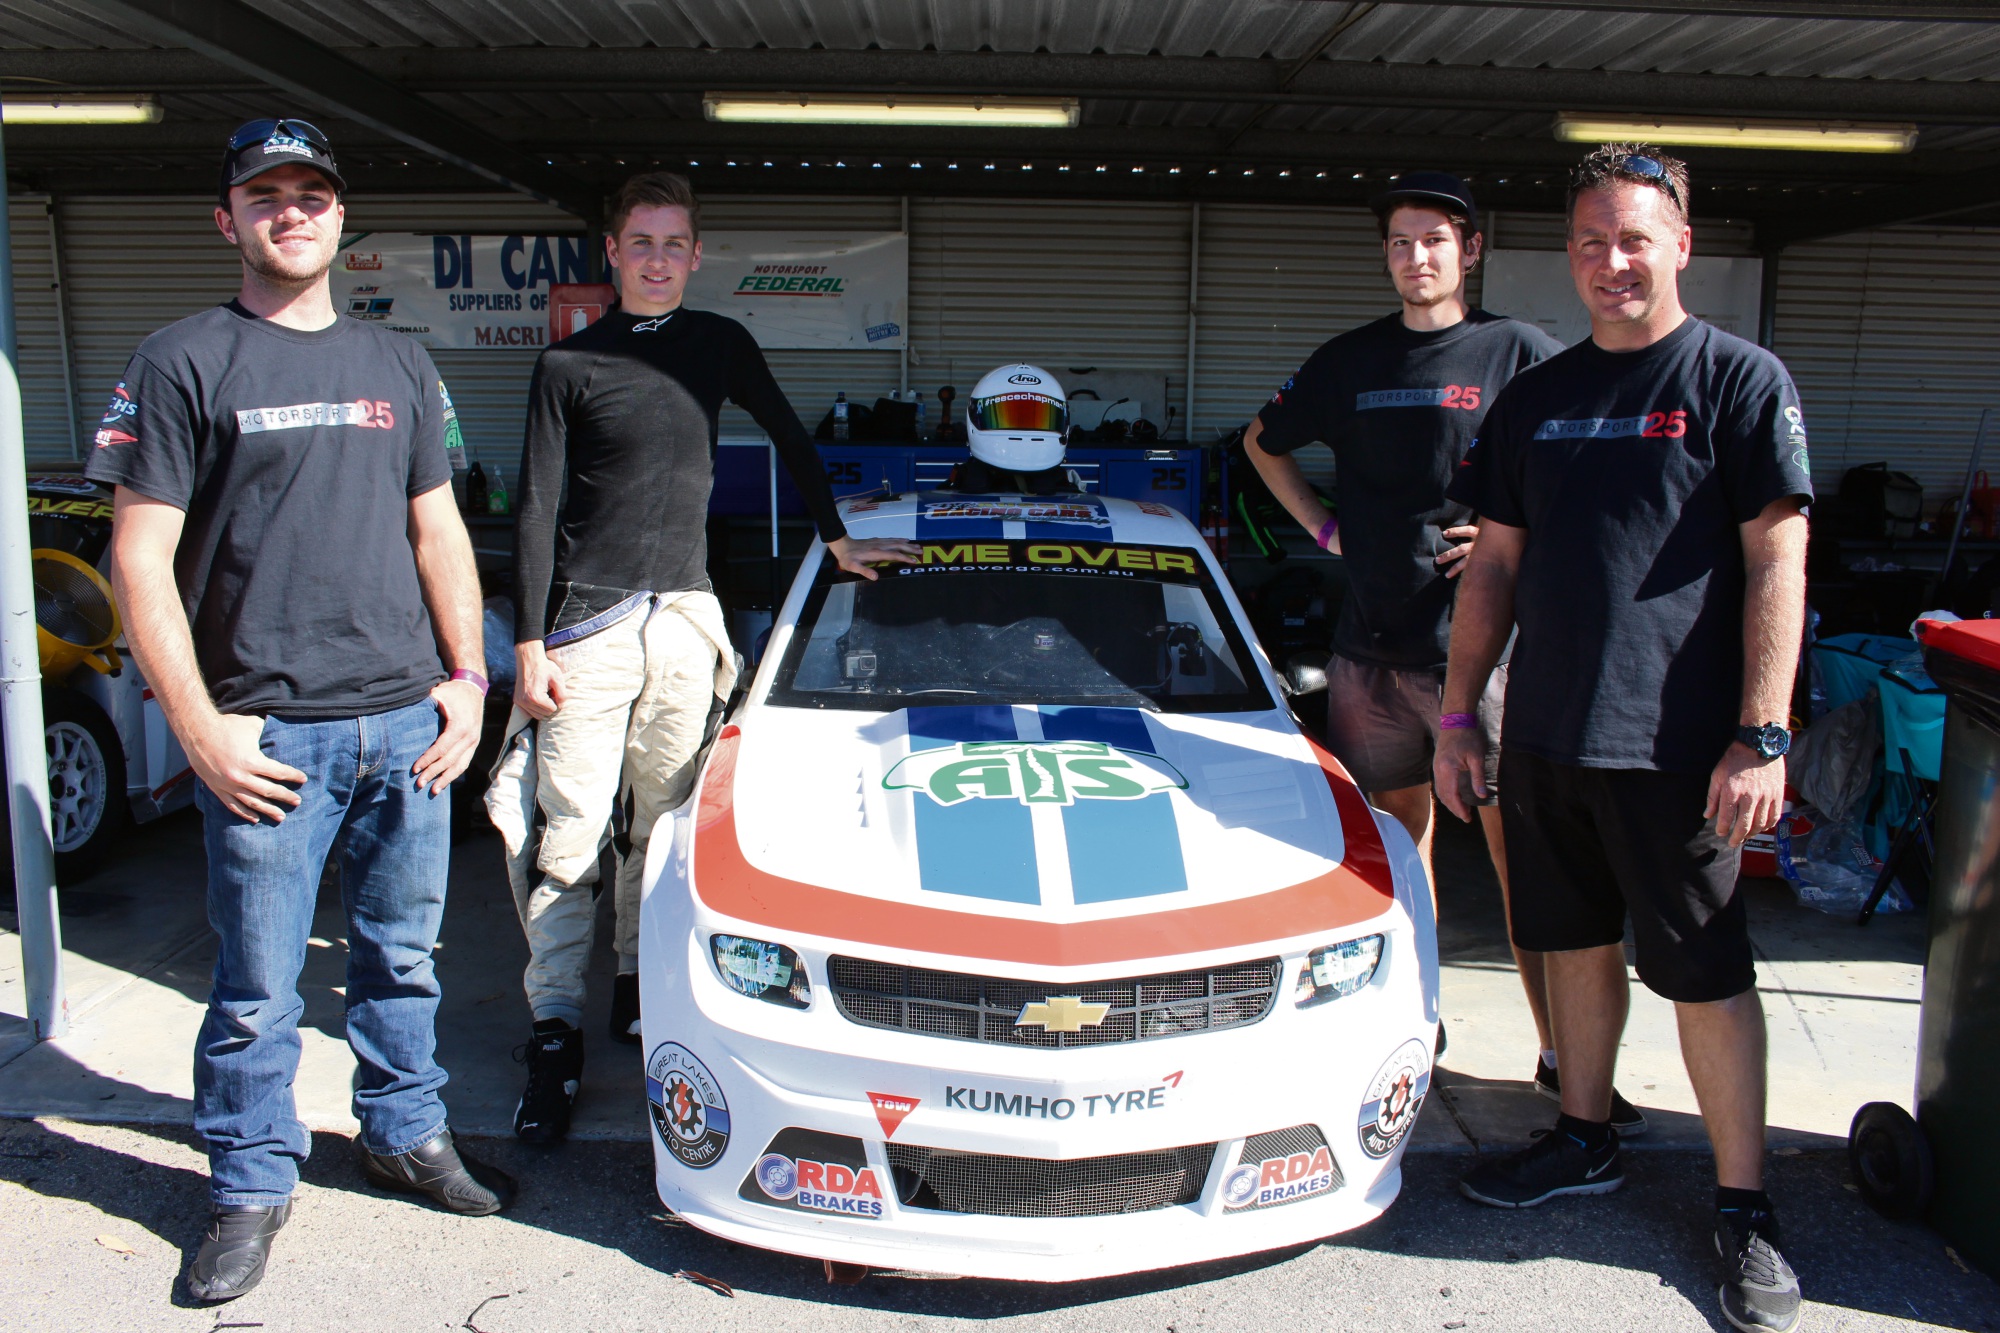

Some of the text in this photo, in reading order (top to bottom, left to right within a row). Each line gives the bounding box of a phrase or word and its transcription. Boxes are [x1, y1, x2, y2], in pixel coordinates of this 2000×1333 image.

[433, 235, 473, 290] DI
[754, 265, 827, 274] MOTORSPORT
[737, 276, 845, 293] FEDERAL
[449, 294, 548, 311] SUPPLIERS OF
[474, 326, 545, 347] MACRI
[1015, 373, 1038, 383] Arai
[1441, 384, 1481, 410] 25
[239, 398, 395, 430] MOTORSPORT 25
[1641, 411, 1687, 438] 25
[826, 461, 862, 485] 25
[1151, 467, 1187, 491] 25
[931, 508, 1092, 518] RACING CARS
[899, 564, 1134, 577] gameovergc.com.au
[1028, 545, 1195, 574] OVER
[655, 1052, 679, 1079] GREAT
[681, 1057, 717, 1105] LAKES
[875, 1098, 912, 1113] TOW
[946, 1085, 1166, 1120] KUMHO TYRE
[658, 1119, 680, 1150] AUTO
[1366, 1132, 1386, 1152] AUTO
[681, 1139, 717, 1161] CENTRE
[798, 1159, 884, 1199] RDA
[1259, 1147, 1331, 1188] RDA
[1259, 1174, 1330, 1203] BRAKES
[799, 1191, 883, 1216] BRAKES
